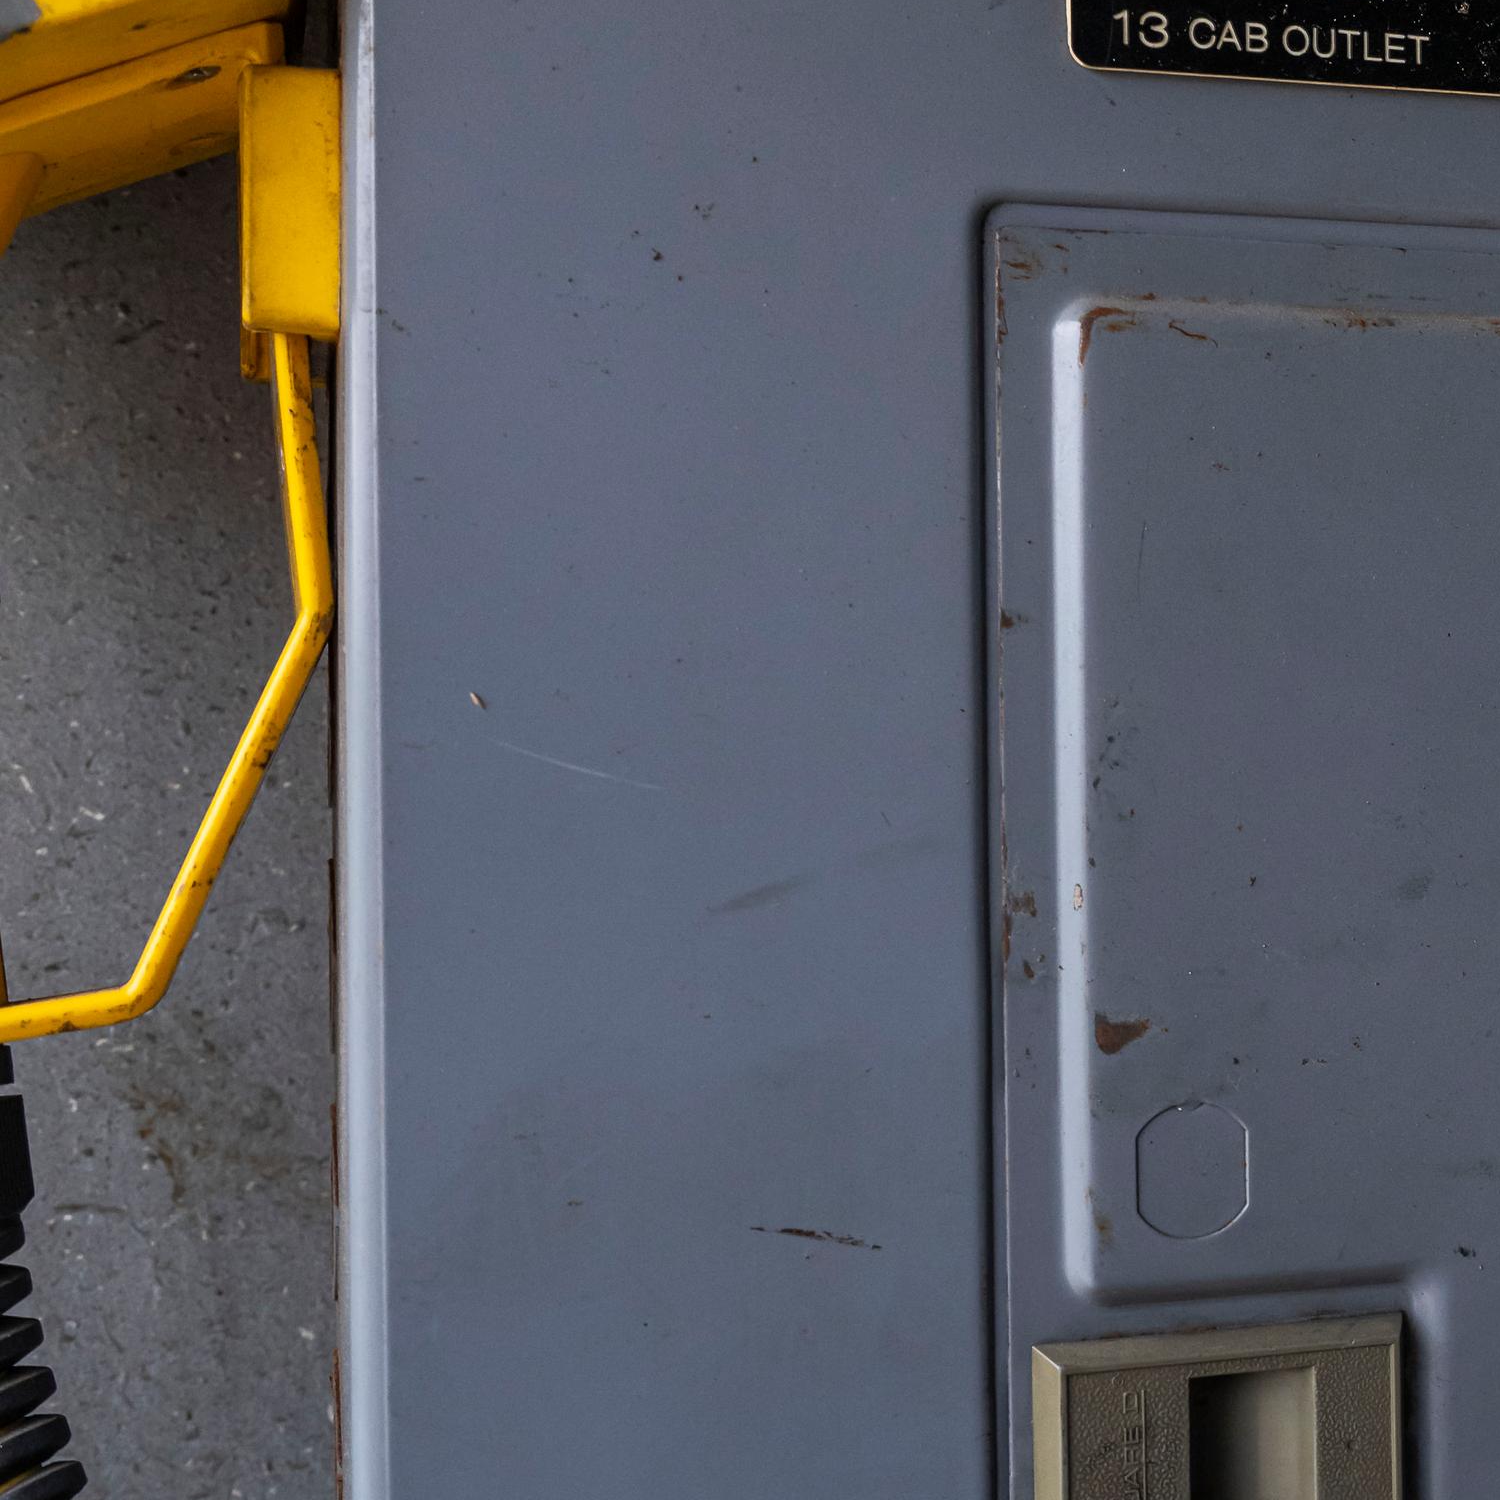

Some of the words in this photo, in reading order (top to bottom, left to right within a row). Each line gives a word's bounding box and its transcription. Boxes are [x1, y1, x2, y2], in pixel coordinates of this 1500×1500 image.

[1113, 9, 1169, 49] 13
[1188, 17, 1269, 53] CAB
[1282, 25, 1430, 65] OUTLET
[1122, 1391, 1140, 1415] D
